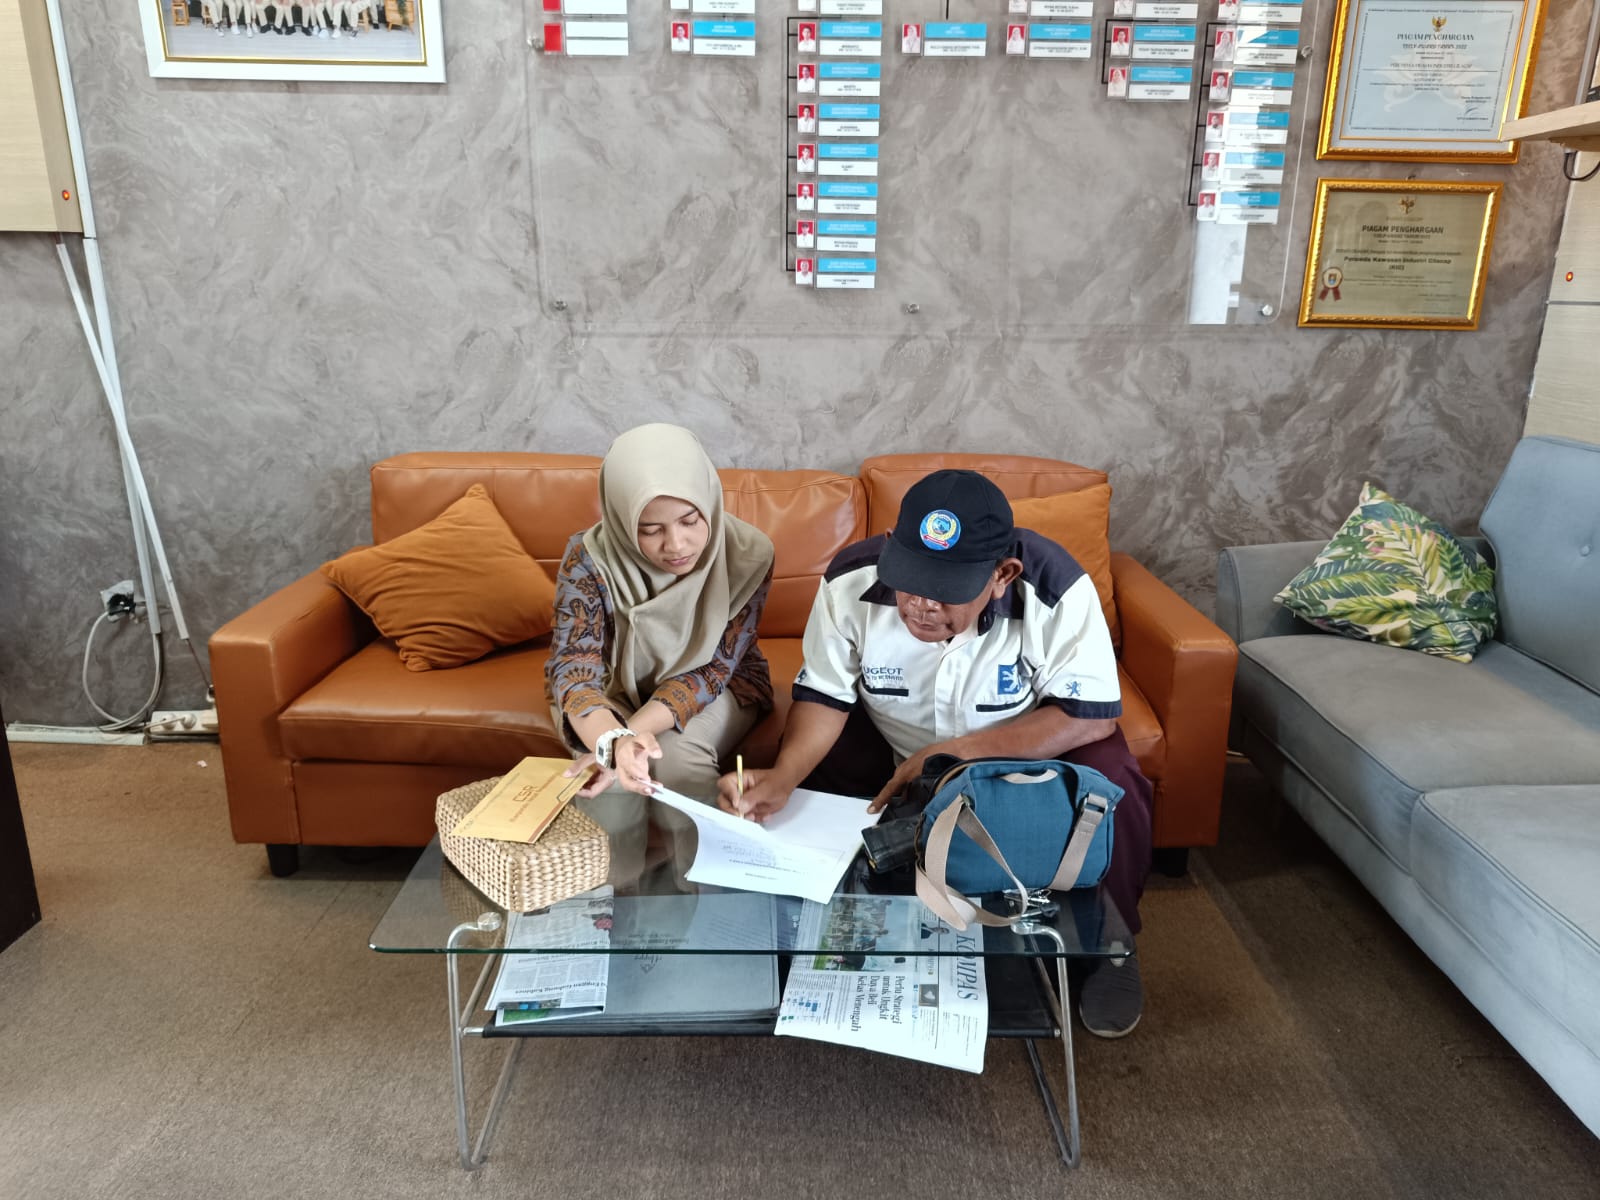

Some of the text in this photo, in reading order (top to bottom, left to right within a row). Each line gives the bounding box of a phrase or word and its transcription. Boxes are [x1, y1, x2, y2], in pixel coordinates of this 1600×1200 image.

[1391, 225, 1444, 234] PENGHARGAAN
[867, 975, 880, 1005] Daya Beli
[956, 934, 979, 1001] KOMPAS
[850, 975, 867, 1032] Kelas Menengah
[878, 975, 891, 1020] untuk Ungkit
[891, 975, 905, 1024] Perlu Strategi
